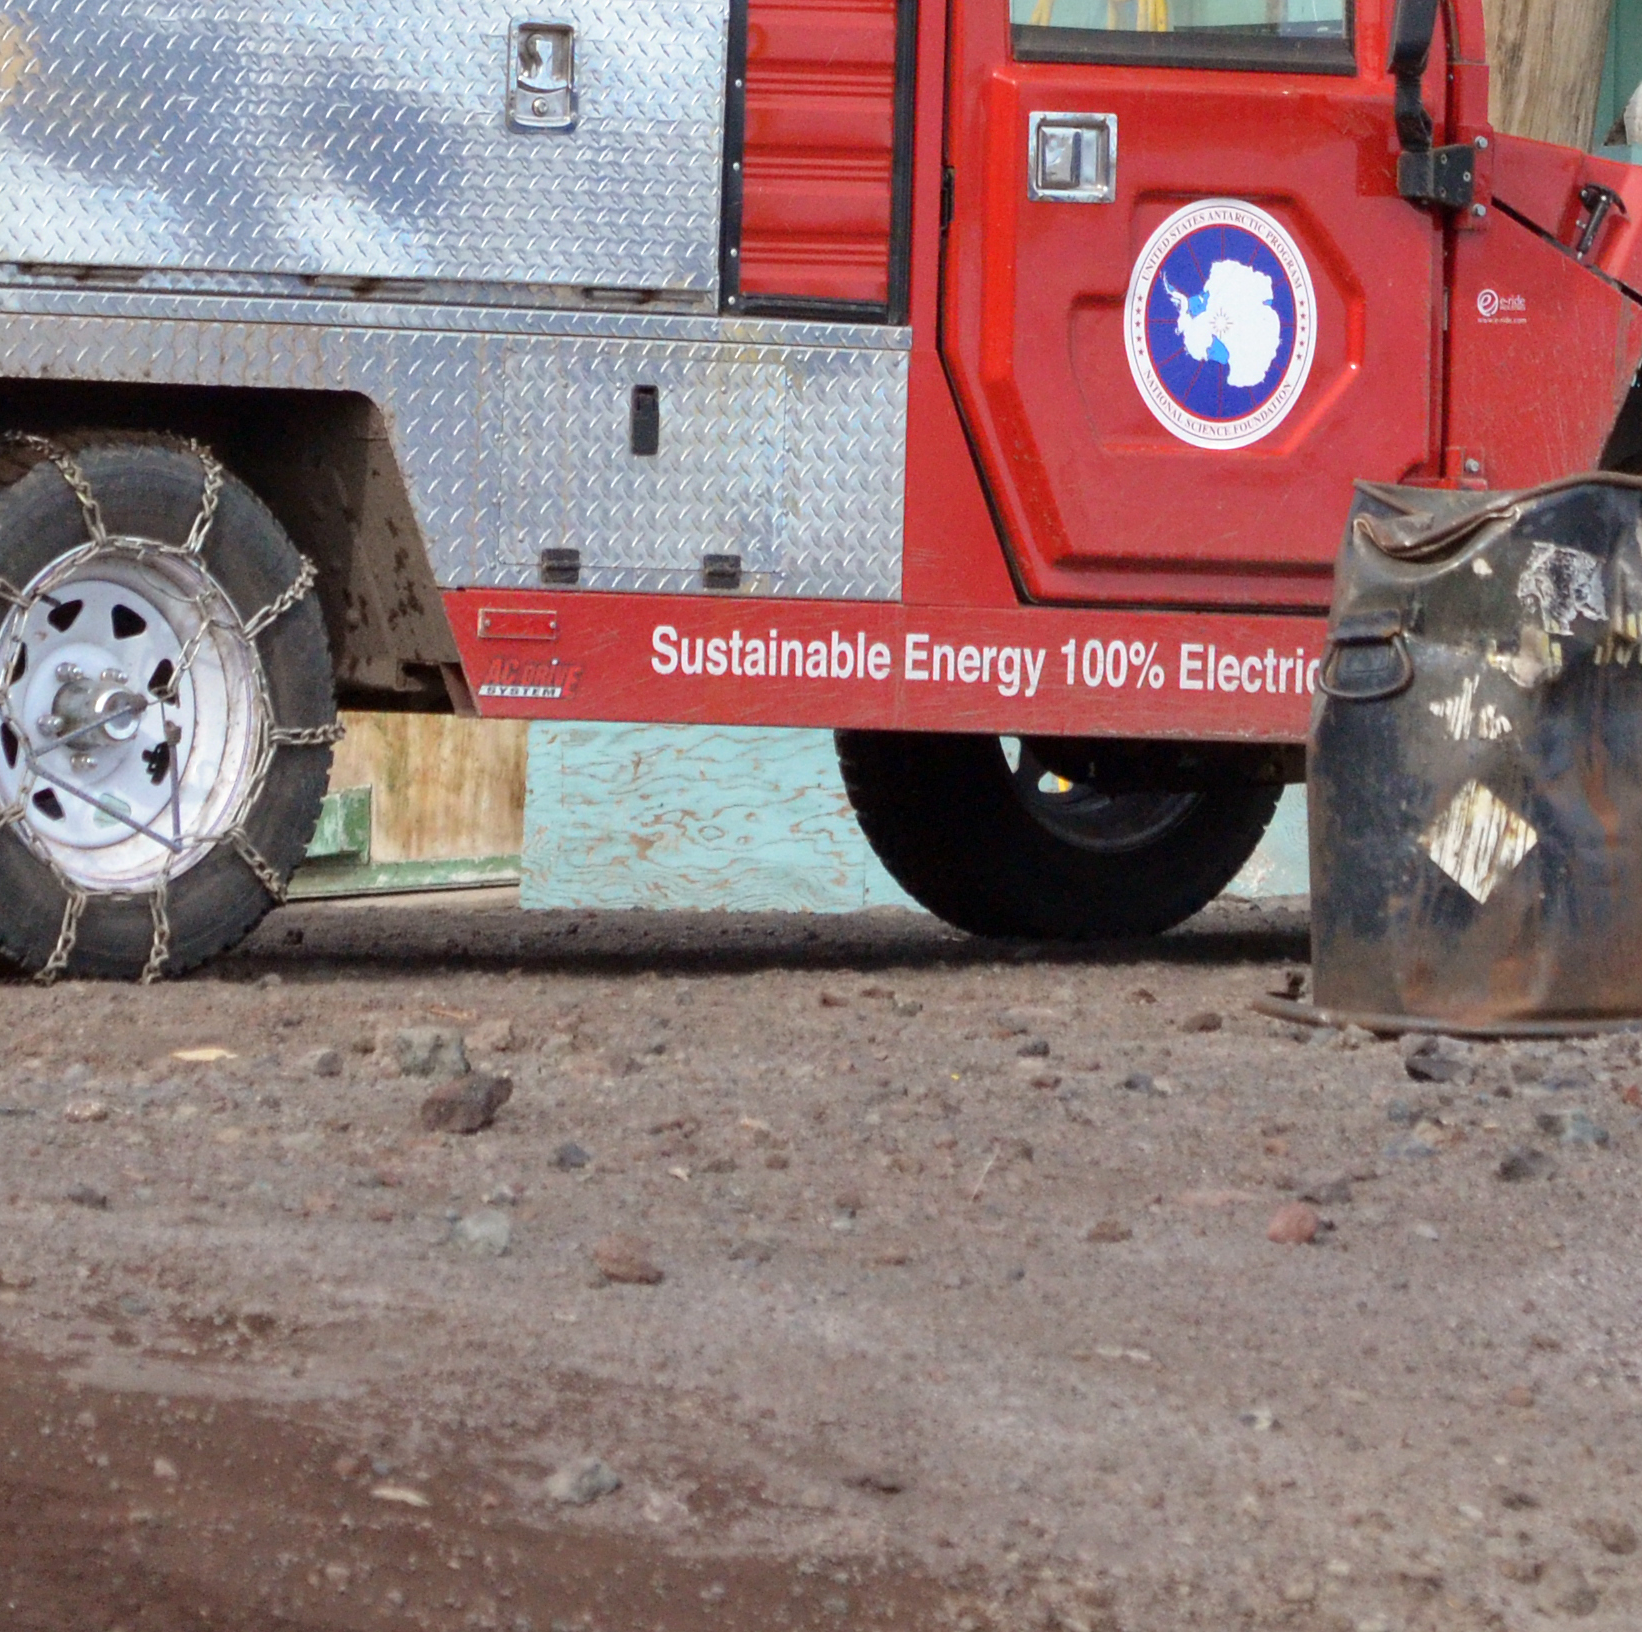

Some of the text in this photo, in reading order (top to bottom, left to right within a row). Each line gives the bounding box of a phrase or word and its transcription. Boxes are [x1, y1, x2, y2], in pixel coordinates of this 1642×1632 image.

[1142, 210, 1302, 290] UNITED STATES ANTARCTIC PROGRAM
[1145, 369, 1292, 436] NATIONAL SCIENCE FOUNDATION
[485, 686, 556, 697] SYSTEM
[651, 624, 891, 681] Sustainable
[904, 633, 1047, 698] Energy
[1060, 638, 1165, 689] 100%
